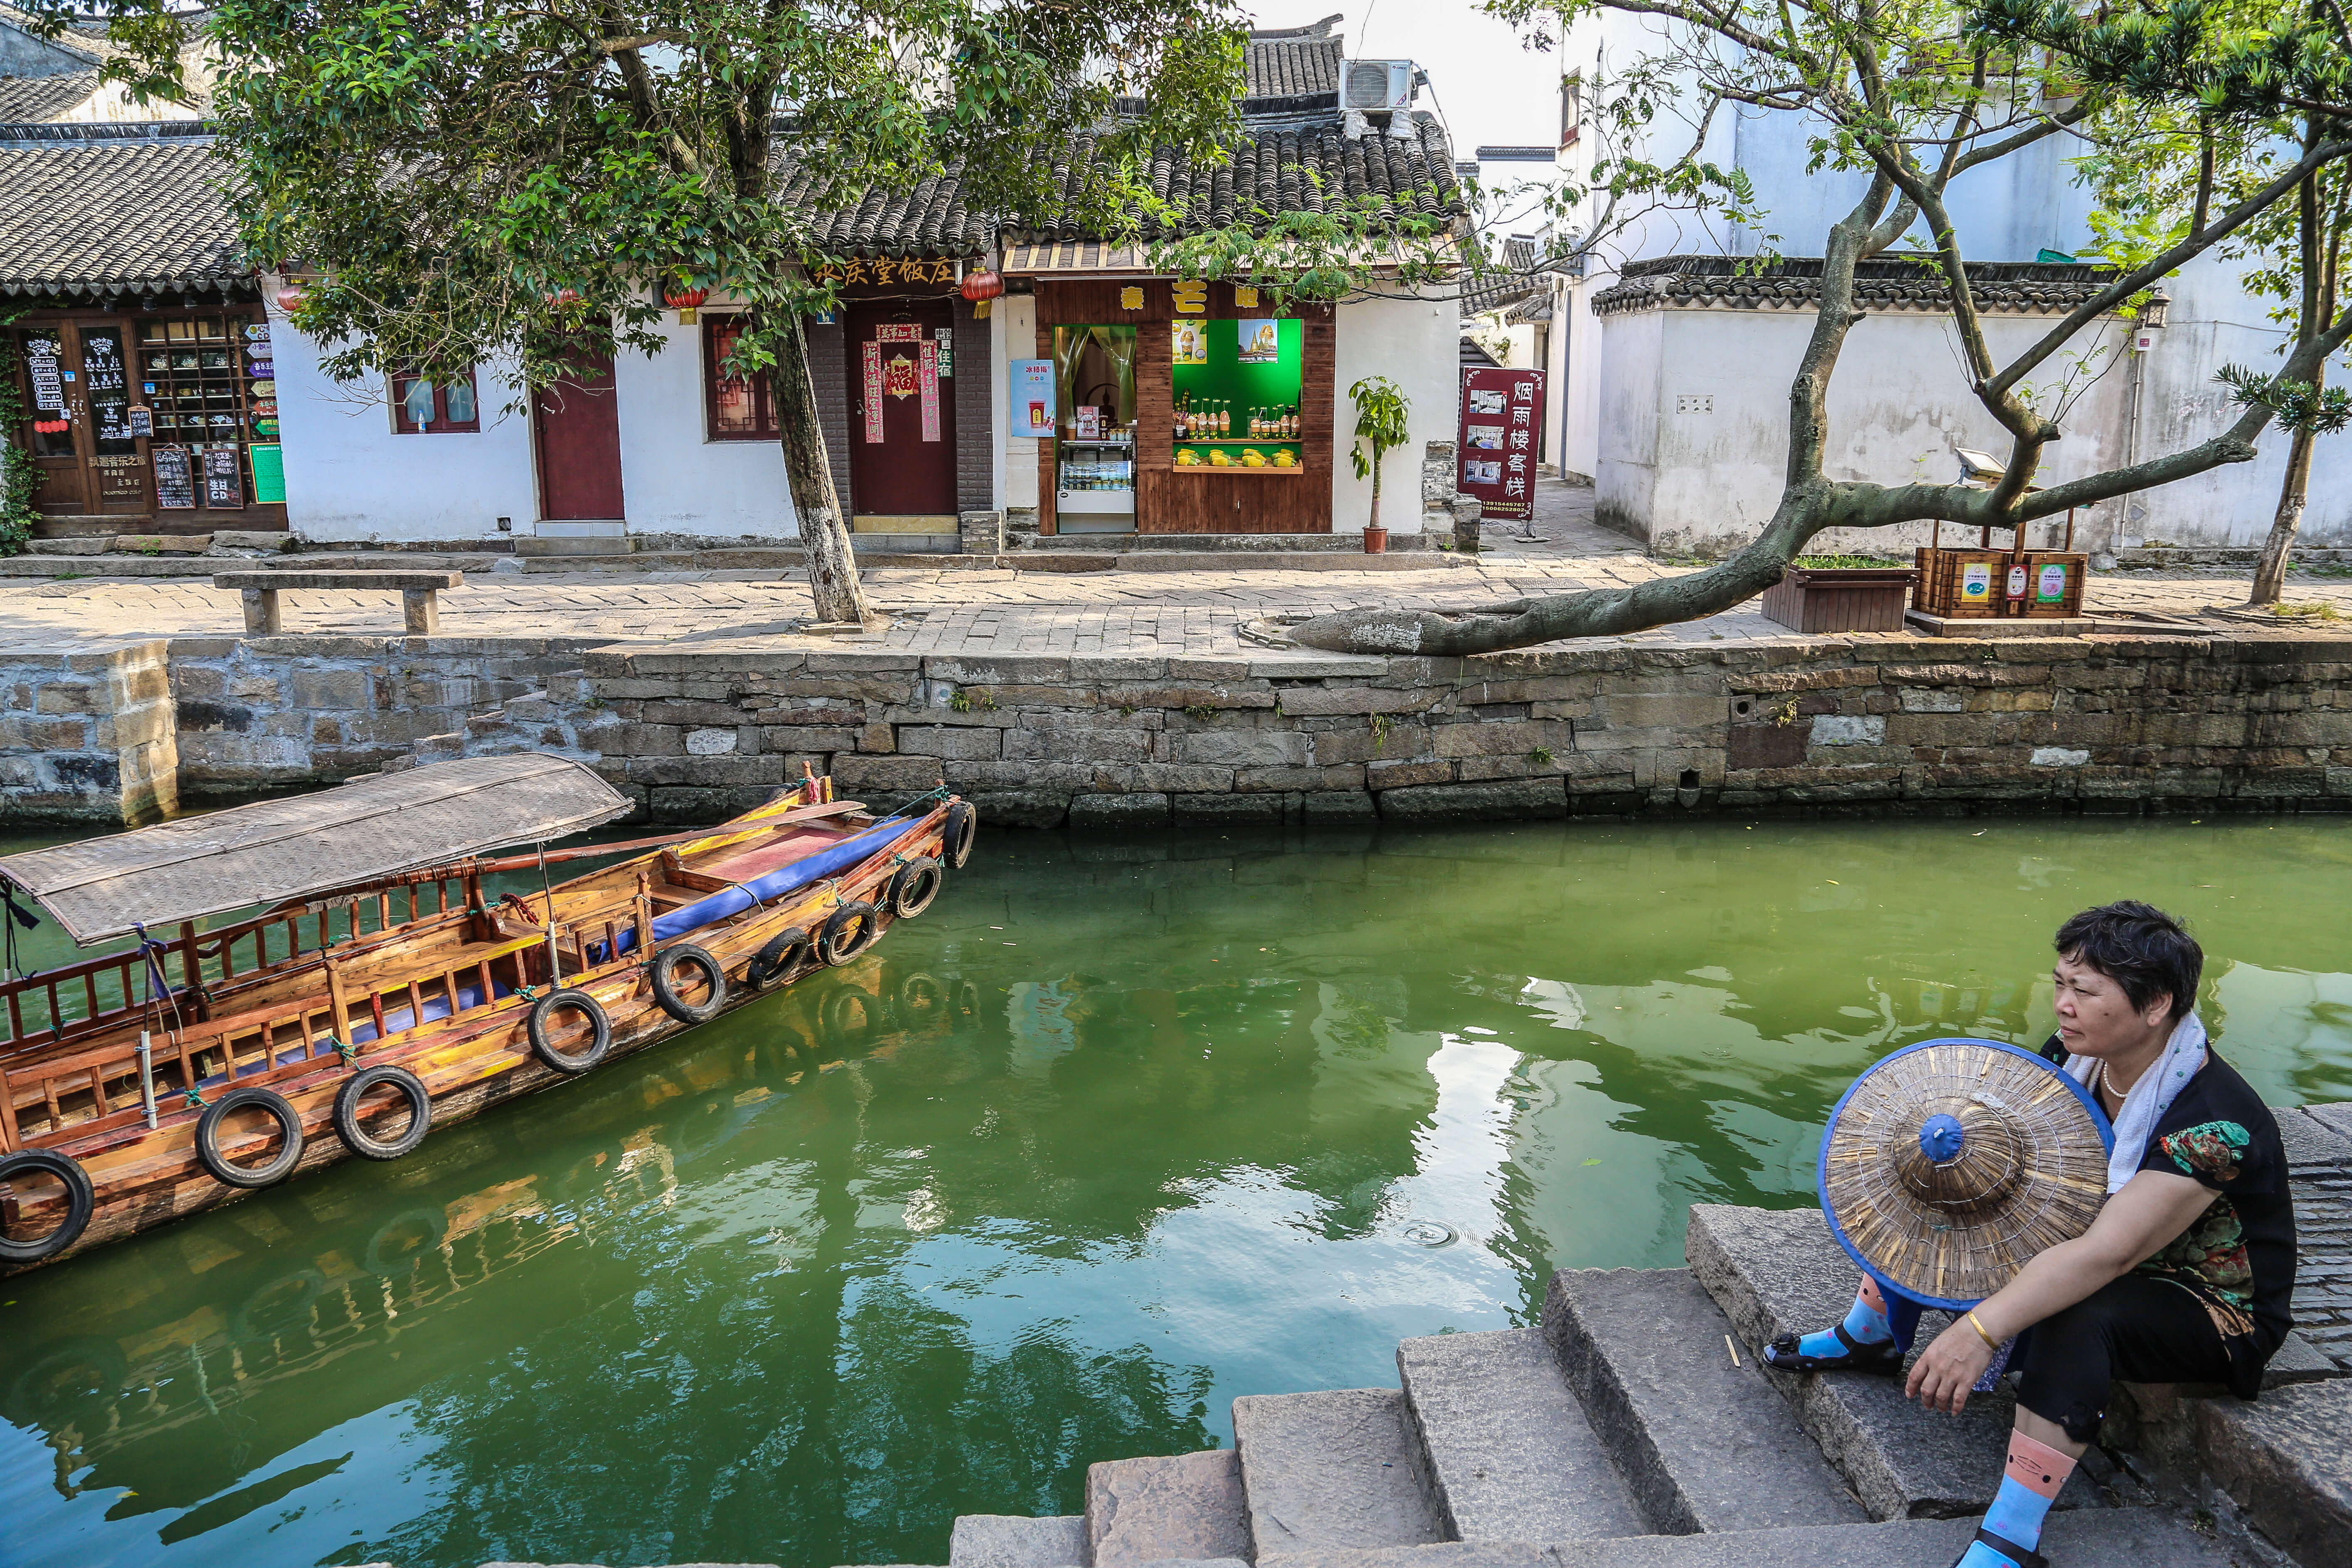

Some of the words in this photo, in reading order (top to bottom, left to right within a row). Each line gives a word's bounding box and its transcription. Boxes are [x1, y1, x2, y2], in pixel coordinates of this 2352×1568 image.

[880, 327, 918, 339] 萬事如意
[936, 329, 952, 339] 电铃
[938, 350, 952, 377] 住宿
[889, 364, 916, 392] 福
[1505, 380, 1534, 500] 烟雨楼客栈
[210, 479, 227, 491] 生日
[211, 491, 227, 500] CD
